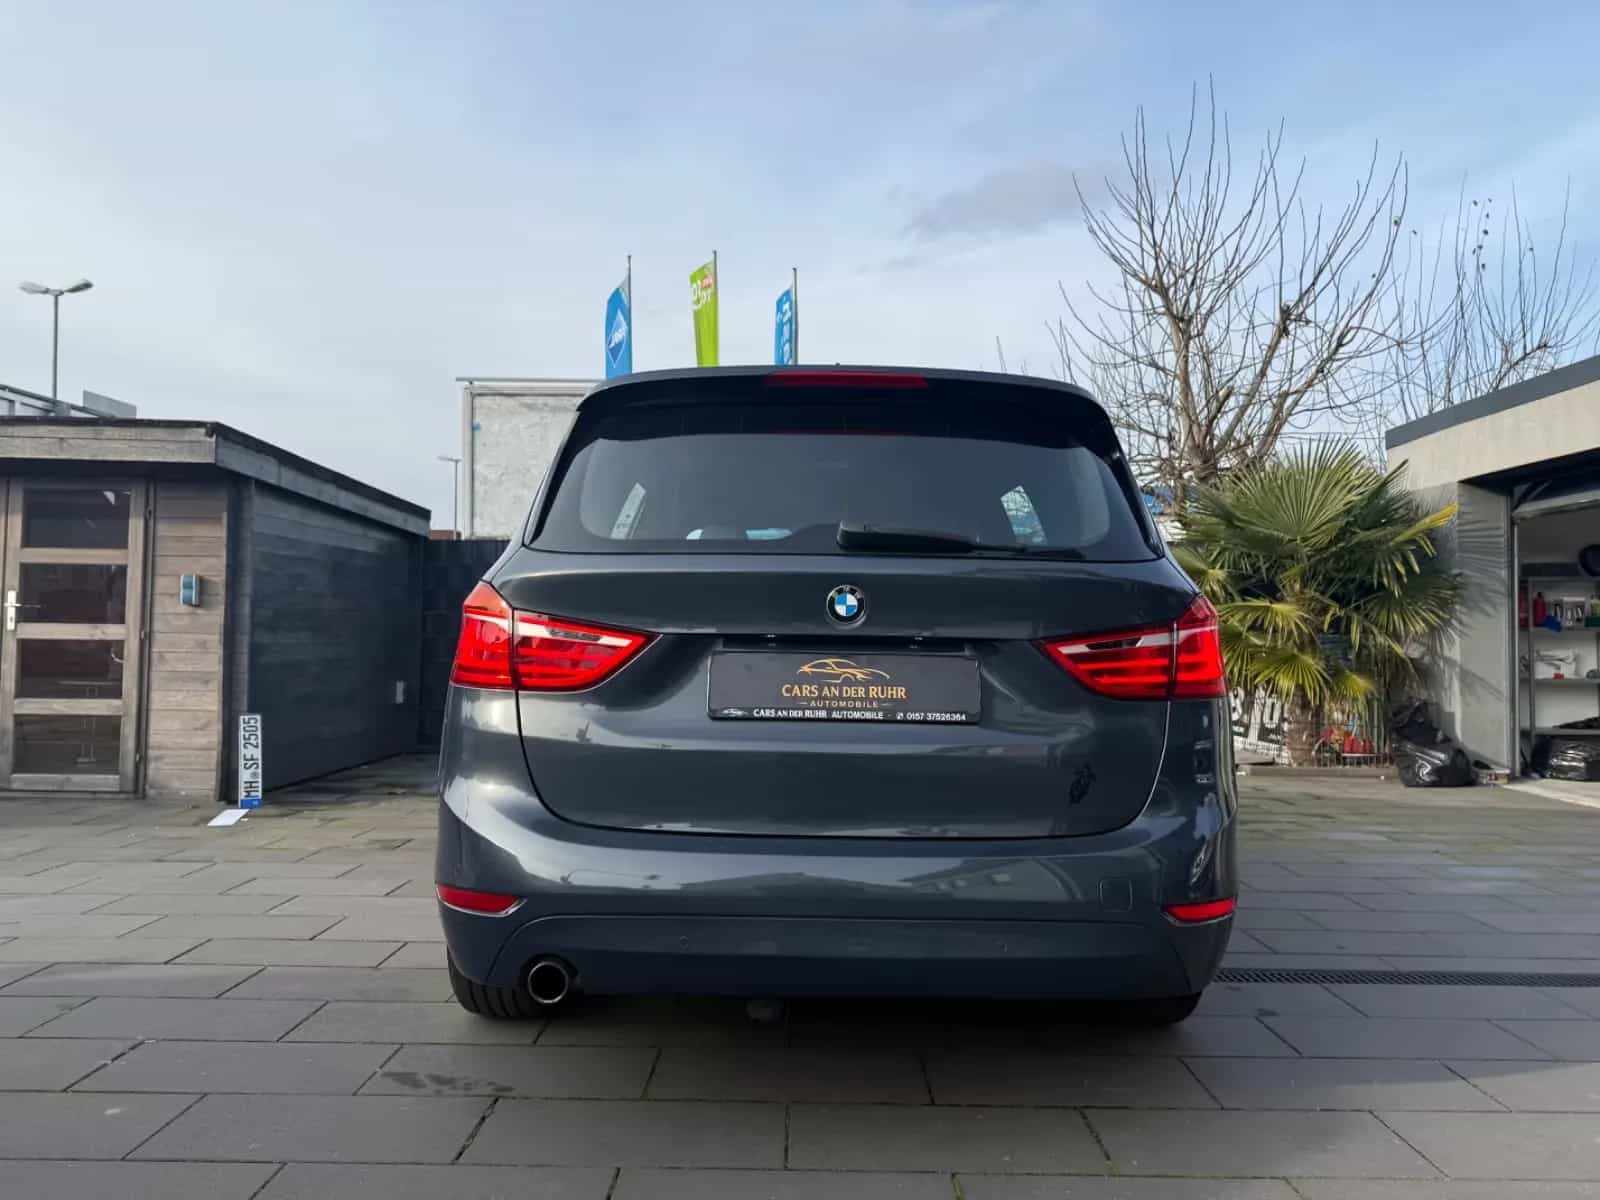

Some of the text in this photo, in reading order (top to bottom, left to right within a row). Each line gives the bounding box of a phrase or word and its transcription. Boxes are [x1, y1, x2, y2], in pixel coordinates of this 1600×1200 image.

[782, 684, 907, 699] CARS AN DER RUHR
[809, 699, 878, 709] AUTOMOBILE
[753, 709, 775, 718] CARS
[777, 710, 788, 718] AN
[789, 710, 803, 718] DER
[804, 709, 827, 719] RUHR
[832, 710, 884, 720] AUTOMOBILE
[243, 716, 260, 749] 2505
[243, 753, 260, 770] SF
